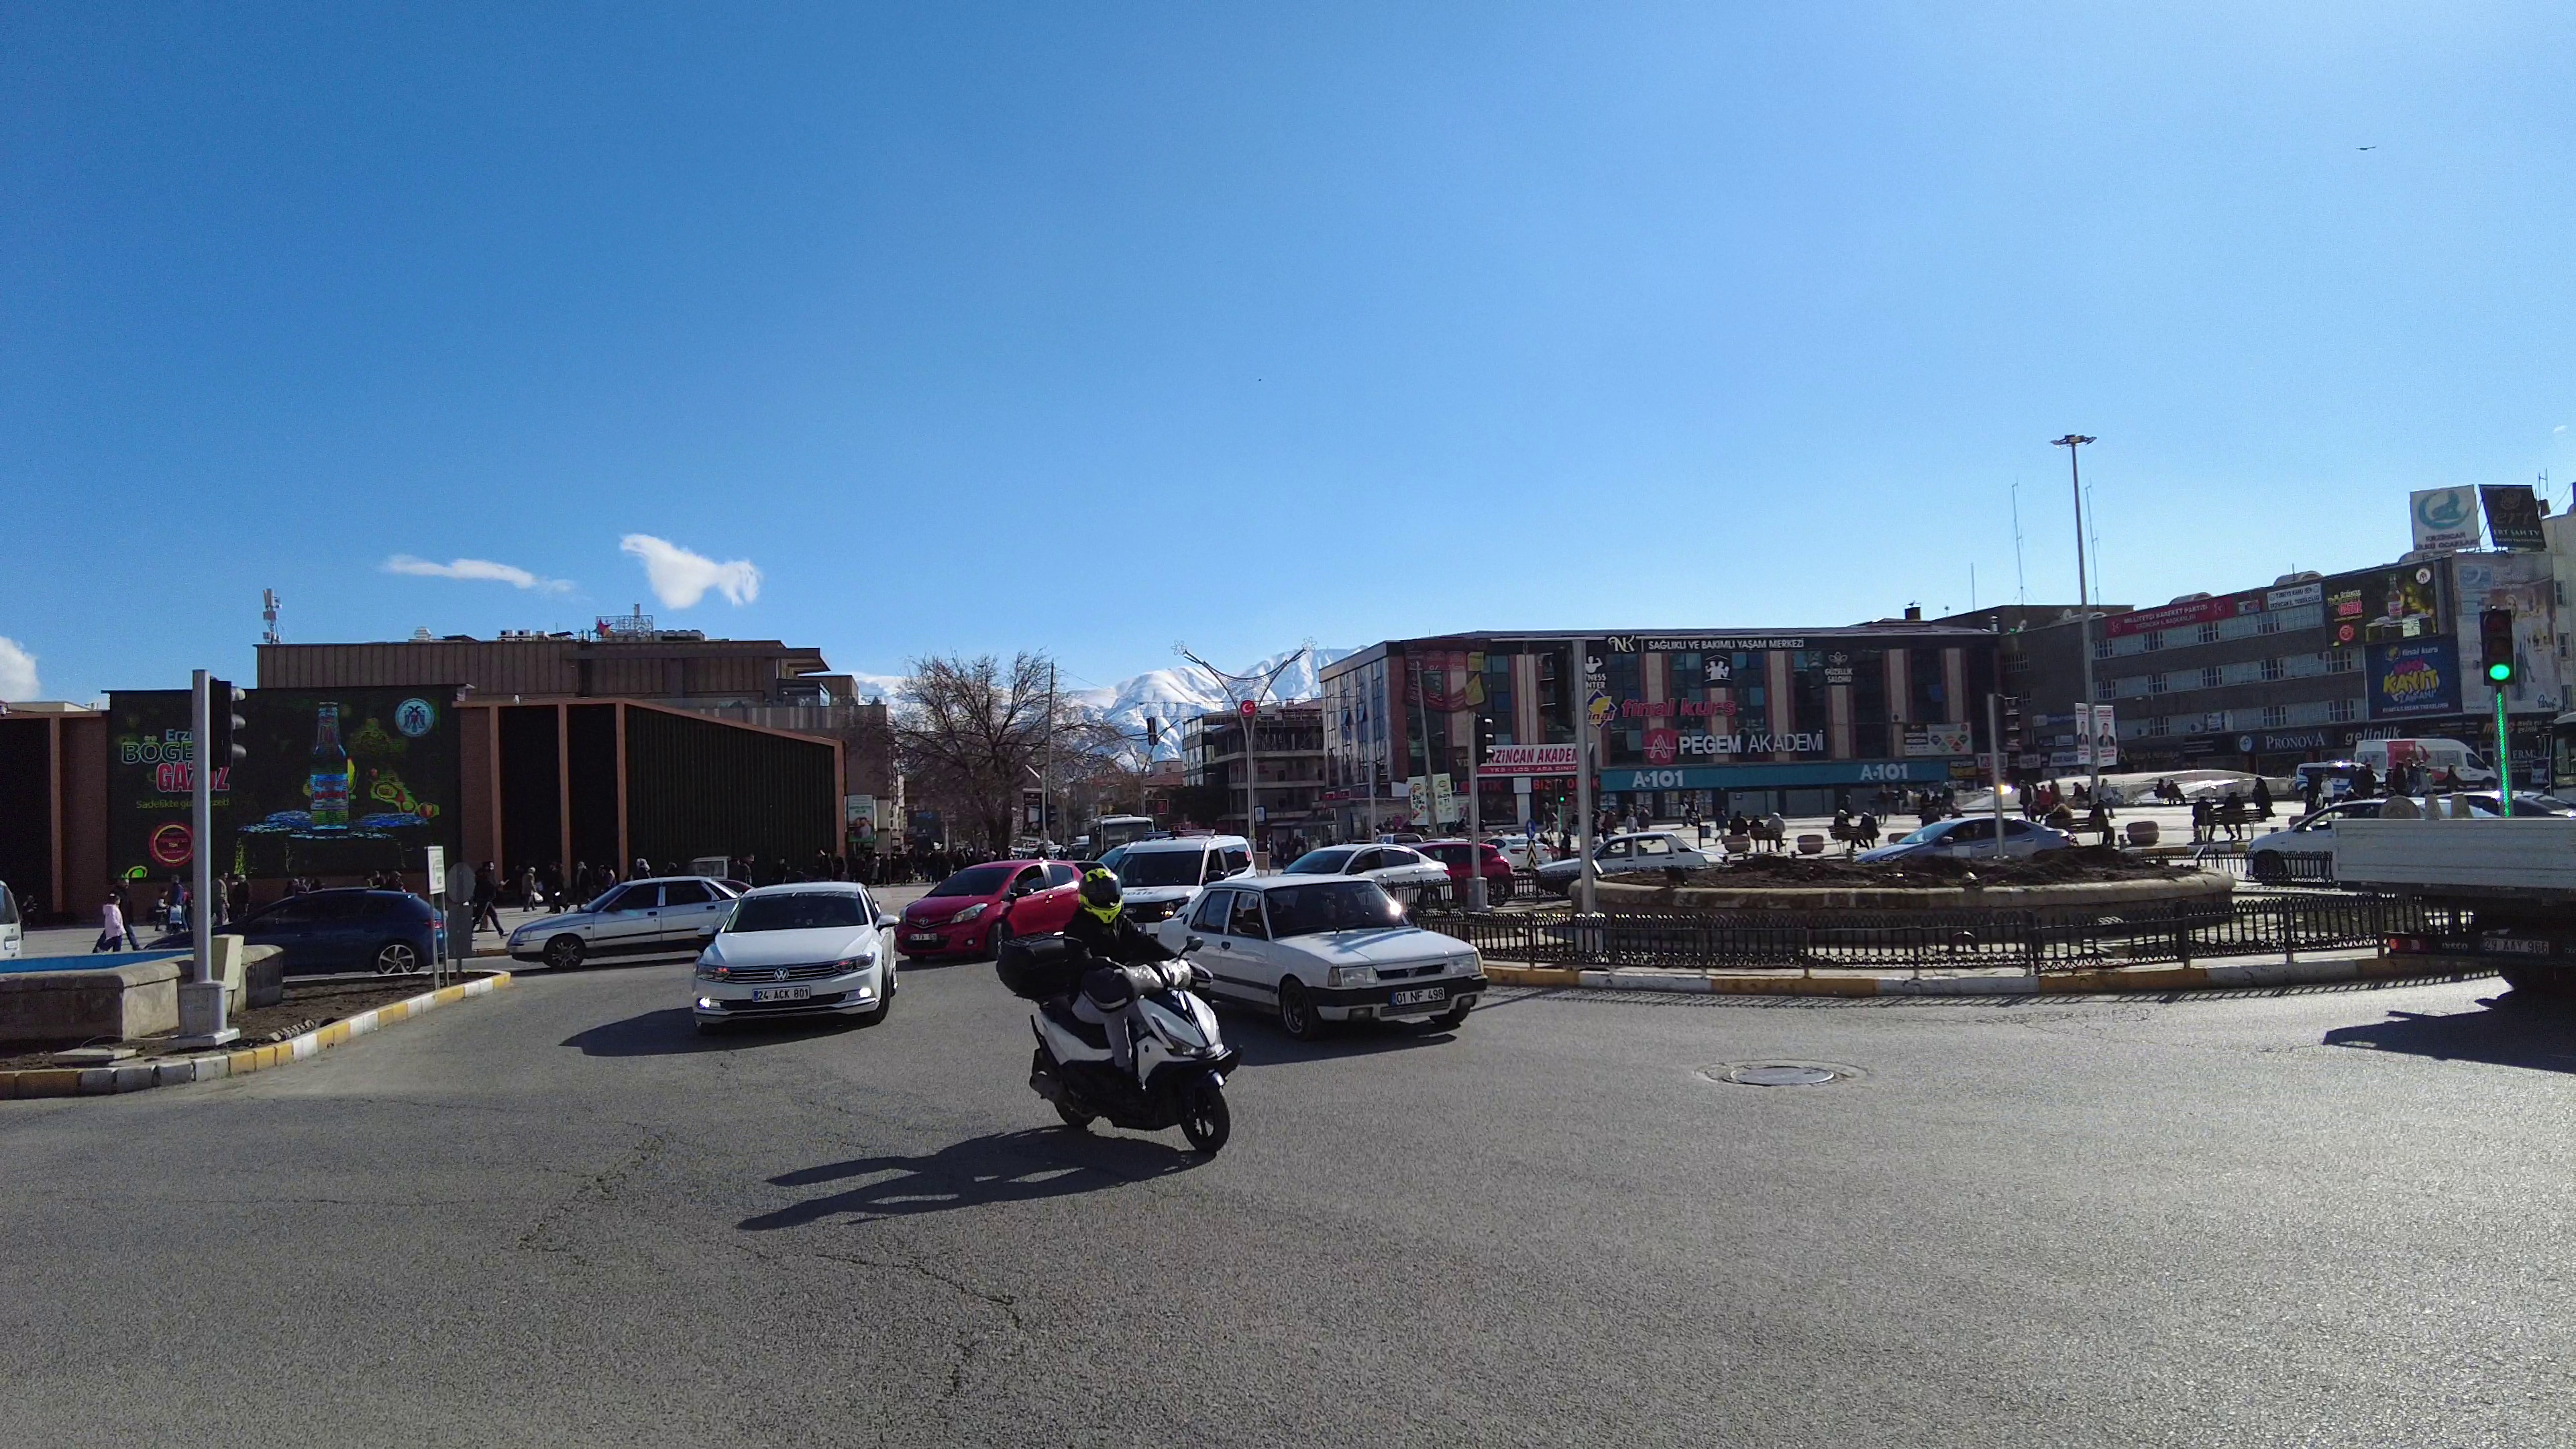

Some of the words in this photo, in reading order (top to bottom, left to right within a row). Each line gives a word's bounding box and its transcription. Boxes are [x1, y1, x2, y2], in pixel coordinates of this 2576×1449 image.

[1648, 640, 1686, 649] SAĞLIKLI
[1689, 641, 1699, 649] VE
[1701, 640, 1735, 649] BAKIMLI
[1737, 639, 1766, 651] YAŞAM
[1769, 638, 1805, 649] MERKEZİ
[1621, 698, 1675, 718] final
[1680, 698, 1736, 717] kurs
[1679, 735, 1741, 755] PEGEM
[1748, 729, 1823, 753] AKADEMİ
[2265, 732, 2325, 749] PRONOVA
[2345, 727, 2401, 745] gelinlik
[758, 990, 769, 1000] 24
[774, 989, 790, 1000] ACK
[794, 988, 809, 998] 801
[1397, 993, 1406, 1004] 01
[1410, 991, 1424, 1002] NF
[1428, 988, 1444, 1000] 498
